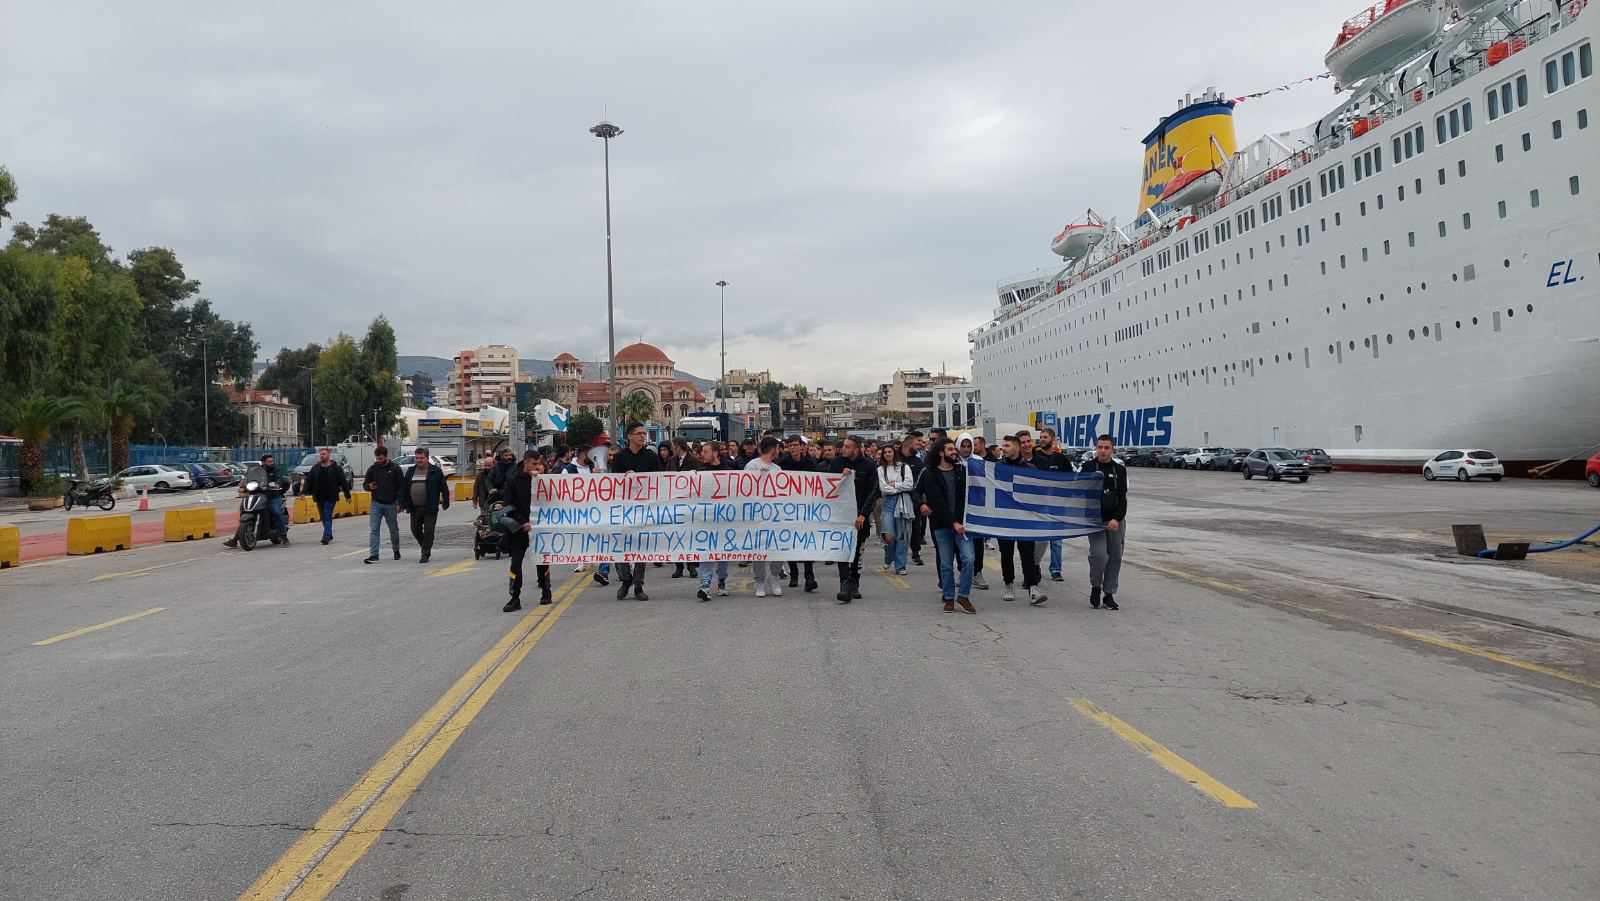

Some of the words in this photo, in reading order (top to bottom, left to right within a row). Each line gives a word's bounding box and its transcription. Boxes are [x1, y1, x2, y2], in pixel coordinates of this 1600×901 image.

[1546, 259, 1584, 287] EL.
[1110, 406, 1173, 446] LINES
[536, 476, 659, 502] ΑΝΑΒΑΘΜΙΣΗ
[664, 474, 702, 499] ΤΩΝ
[537, 506, 601, 525] ΜΟΝΙΜΟ
[610, 502, 736, 525] ΕΚΠΑΙΔΕΥΤΙΚΟ
[742, 502, 832, 522] ΠΡΟΣΩΠΙΚΟ
[534, 531, 632, 554] ΙΣΟΤΙΜΗΣΗ
[638, 529, 719, 551] ΠΤΥΧΙΩΝ
[723, 528, 738, 551] &
[742, 528, 854, 551] ΔΙΠΛΩΜΑΤΩΝ
